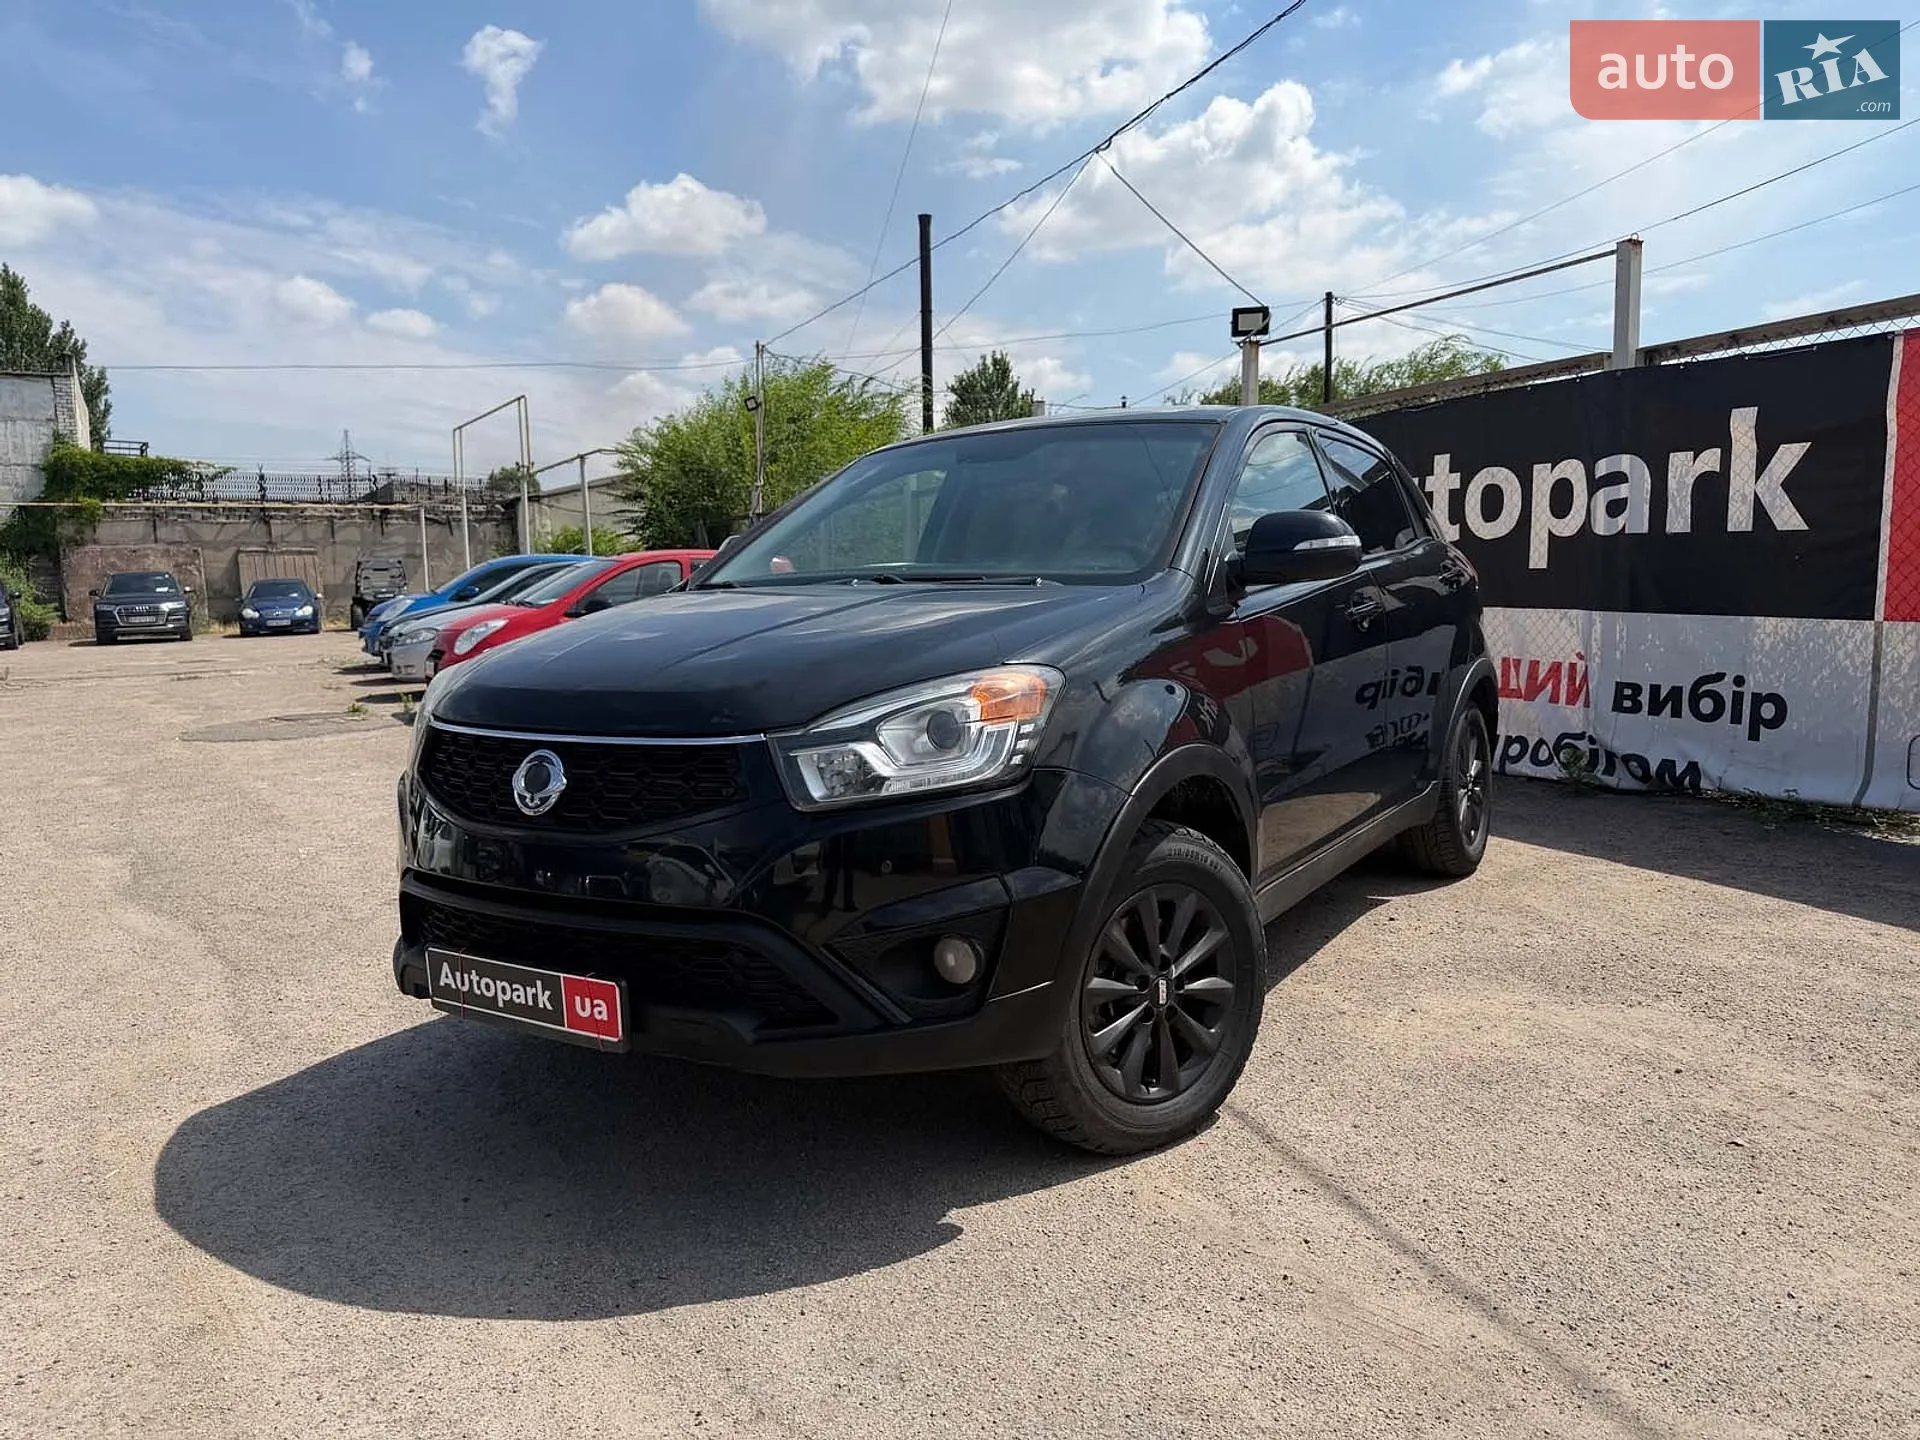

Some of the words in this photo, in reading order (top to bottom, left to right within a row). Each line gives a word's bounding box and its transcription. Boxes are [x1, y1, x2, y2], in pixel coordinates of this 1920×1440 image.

[1412, 407, 1813, 570] topark
[1611, 672, 1788, 742] вибір
[1494, 731, 1703, 791] робігом
[438, 961, 554, 1011] Autopark
[574, 995, 609, 1021] ua
